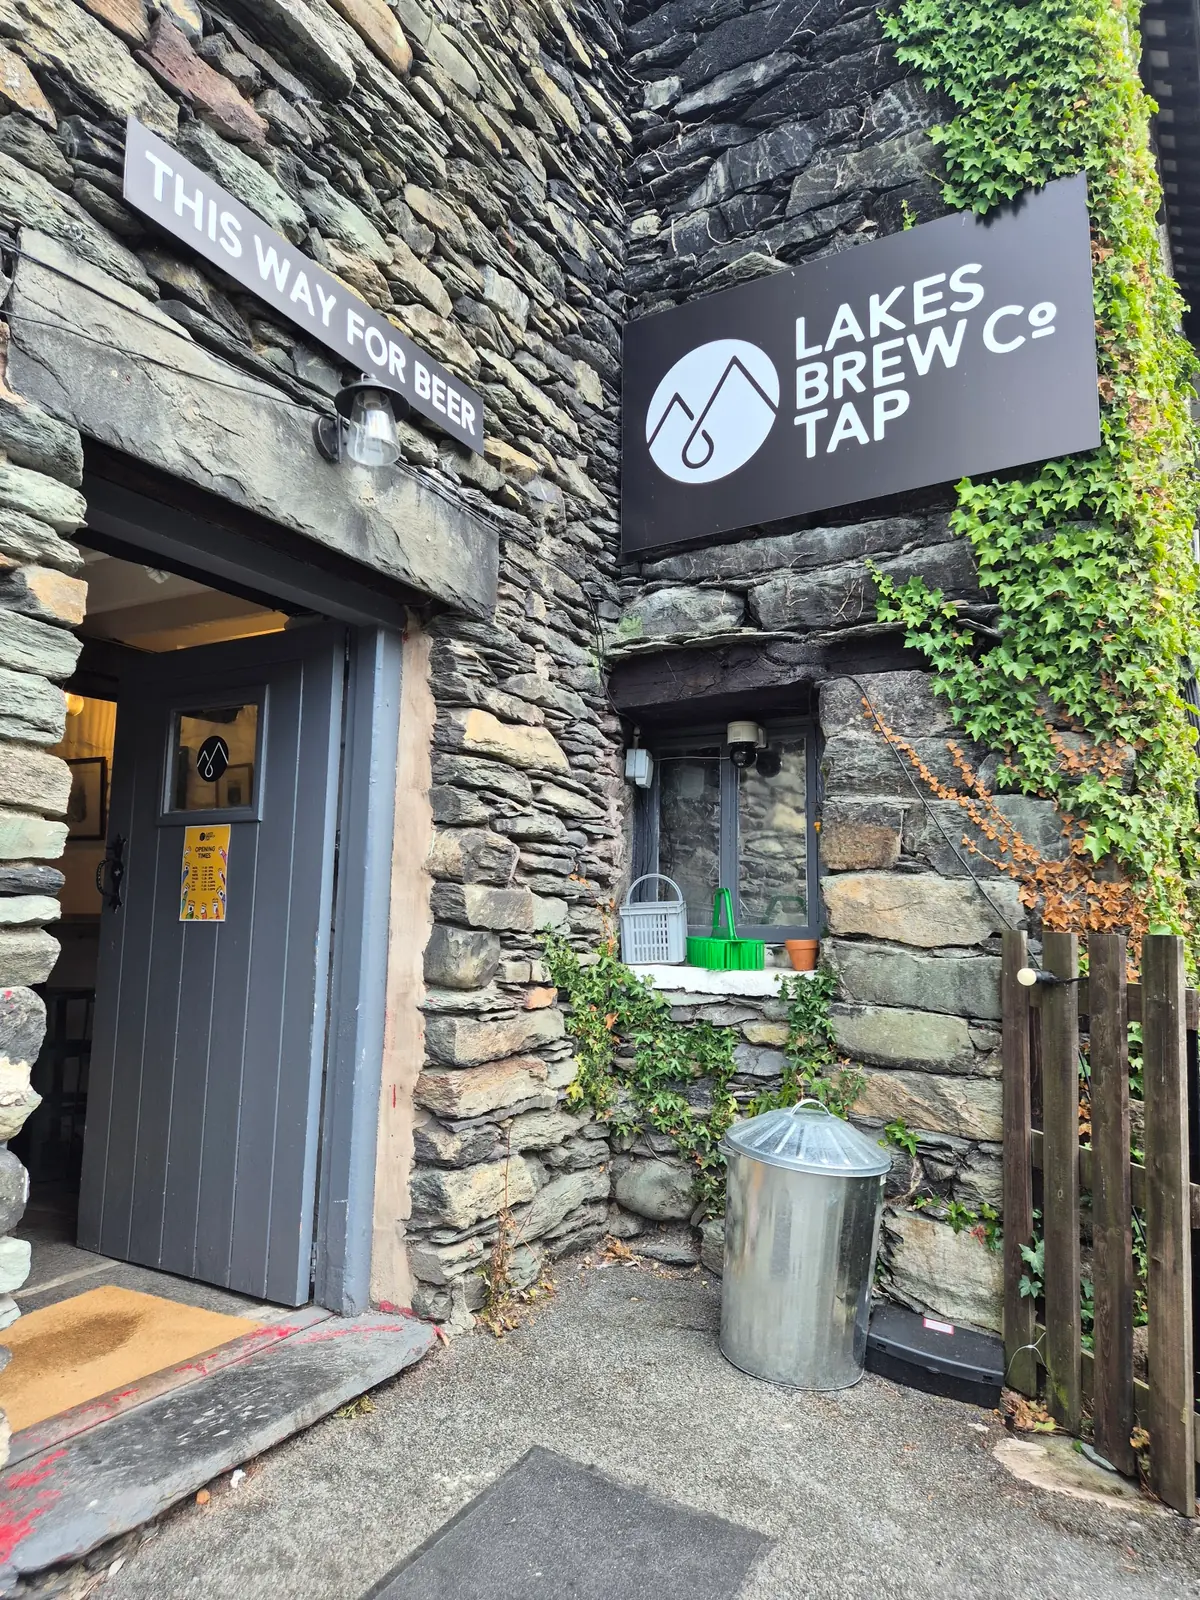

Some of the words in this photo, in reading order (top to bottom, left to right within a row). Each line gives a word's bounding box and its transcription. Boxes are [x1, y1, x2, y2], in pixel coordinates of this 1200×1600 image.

[145, 150, 244, 259] THIS
[254, 233, 337, 328] WAY
[346, 308, 406, 384] FOR
[414, 360, 476, 436] BEER
[794, 262, 985, 361] LAKES
[795, 318, 968, 410] BREW
[793, 388, 911, 459] TAP
